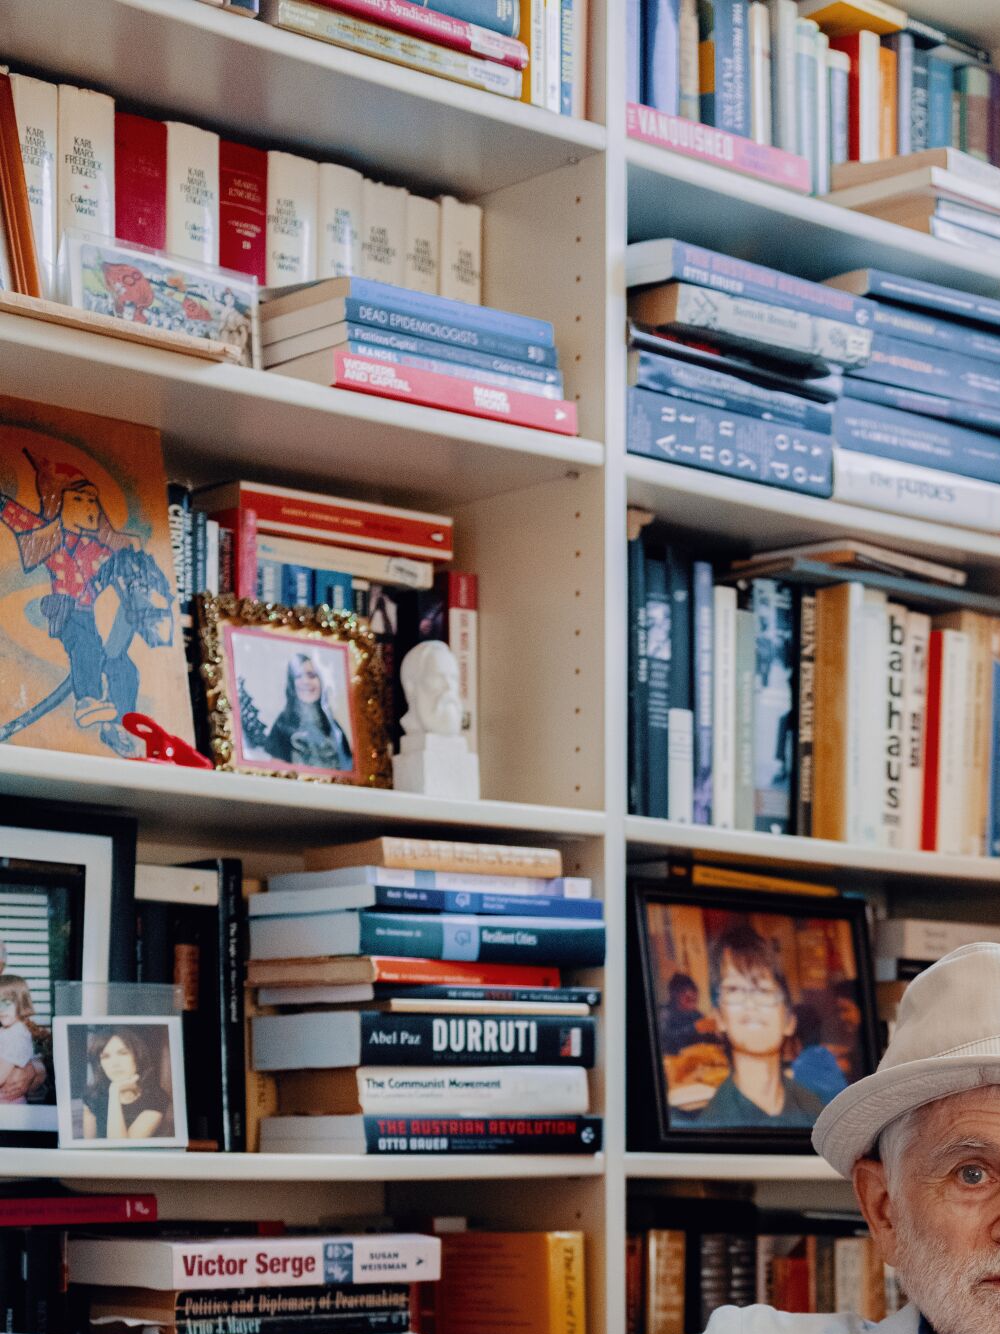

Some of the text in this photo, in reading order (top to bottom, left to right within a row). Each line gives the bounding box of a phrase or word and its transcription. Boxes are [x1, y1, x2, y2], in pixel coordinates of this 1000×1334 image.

[390, 1, 455, 35] Syndicalism
[73, 136, 93, 149] KARL
[637, 107, 734, 162] VANQUISHED
[73, 146, 96, 159] MARX
[65, 154, 102, 171] FREDERICK
[71, 165, 97, 179] ENGELS
[70, 193, 98, 208] Collected
[75, 204, 96, 217] Works
[359, 305, 388, 324] DEAD
[389, 313, 479, 346] EPIDEMIOLOGISTS
[357, 345, 398, 362] MANDEL
[887, 614, 906, 809] bauhaus
[482, 929, 538, 945] Resilient Cities
[369, 1018, 538, 1053] Abel Paz DURRUTI
[366, 1078, 501, 1090] The Communist Movement
[377, 1119, 577, 1136] THE AUSTRIAN REVOLUTION
[378, 1137, 448, 1151] OTTO BAUER
[369, 1252, 400, 1260] SUSAN
[182, 1252, 316, 1278] Victor Serge
[360, 1262, 408, 1272] WEISSMAN
[185, 1288, 407, 1316] Politics and Diplomacy of Peacemaking
